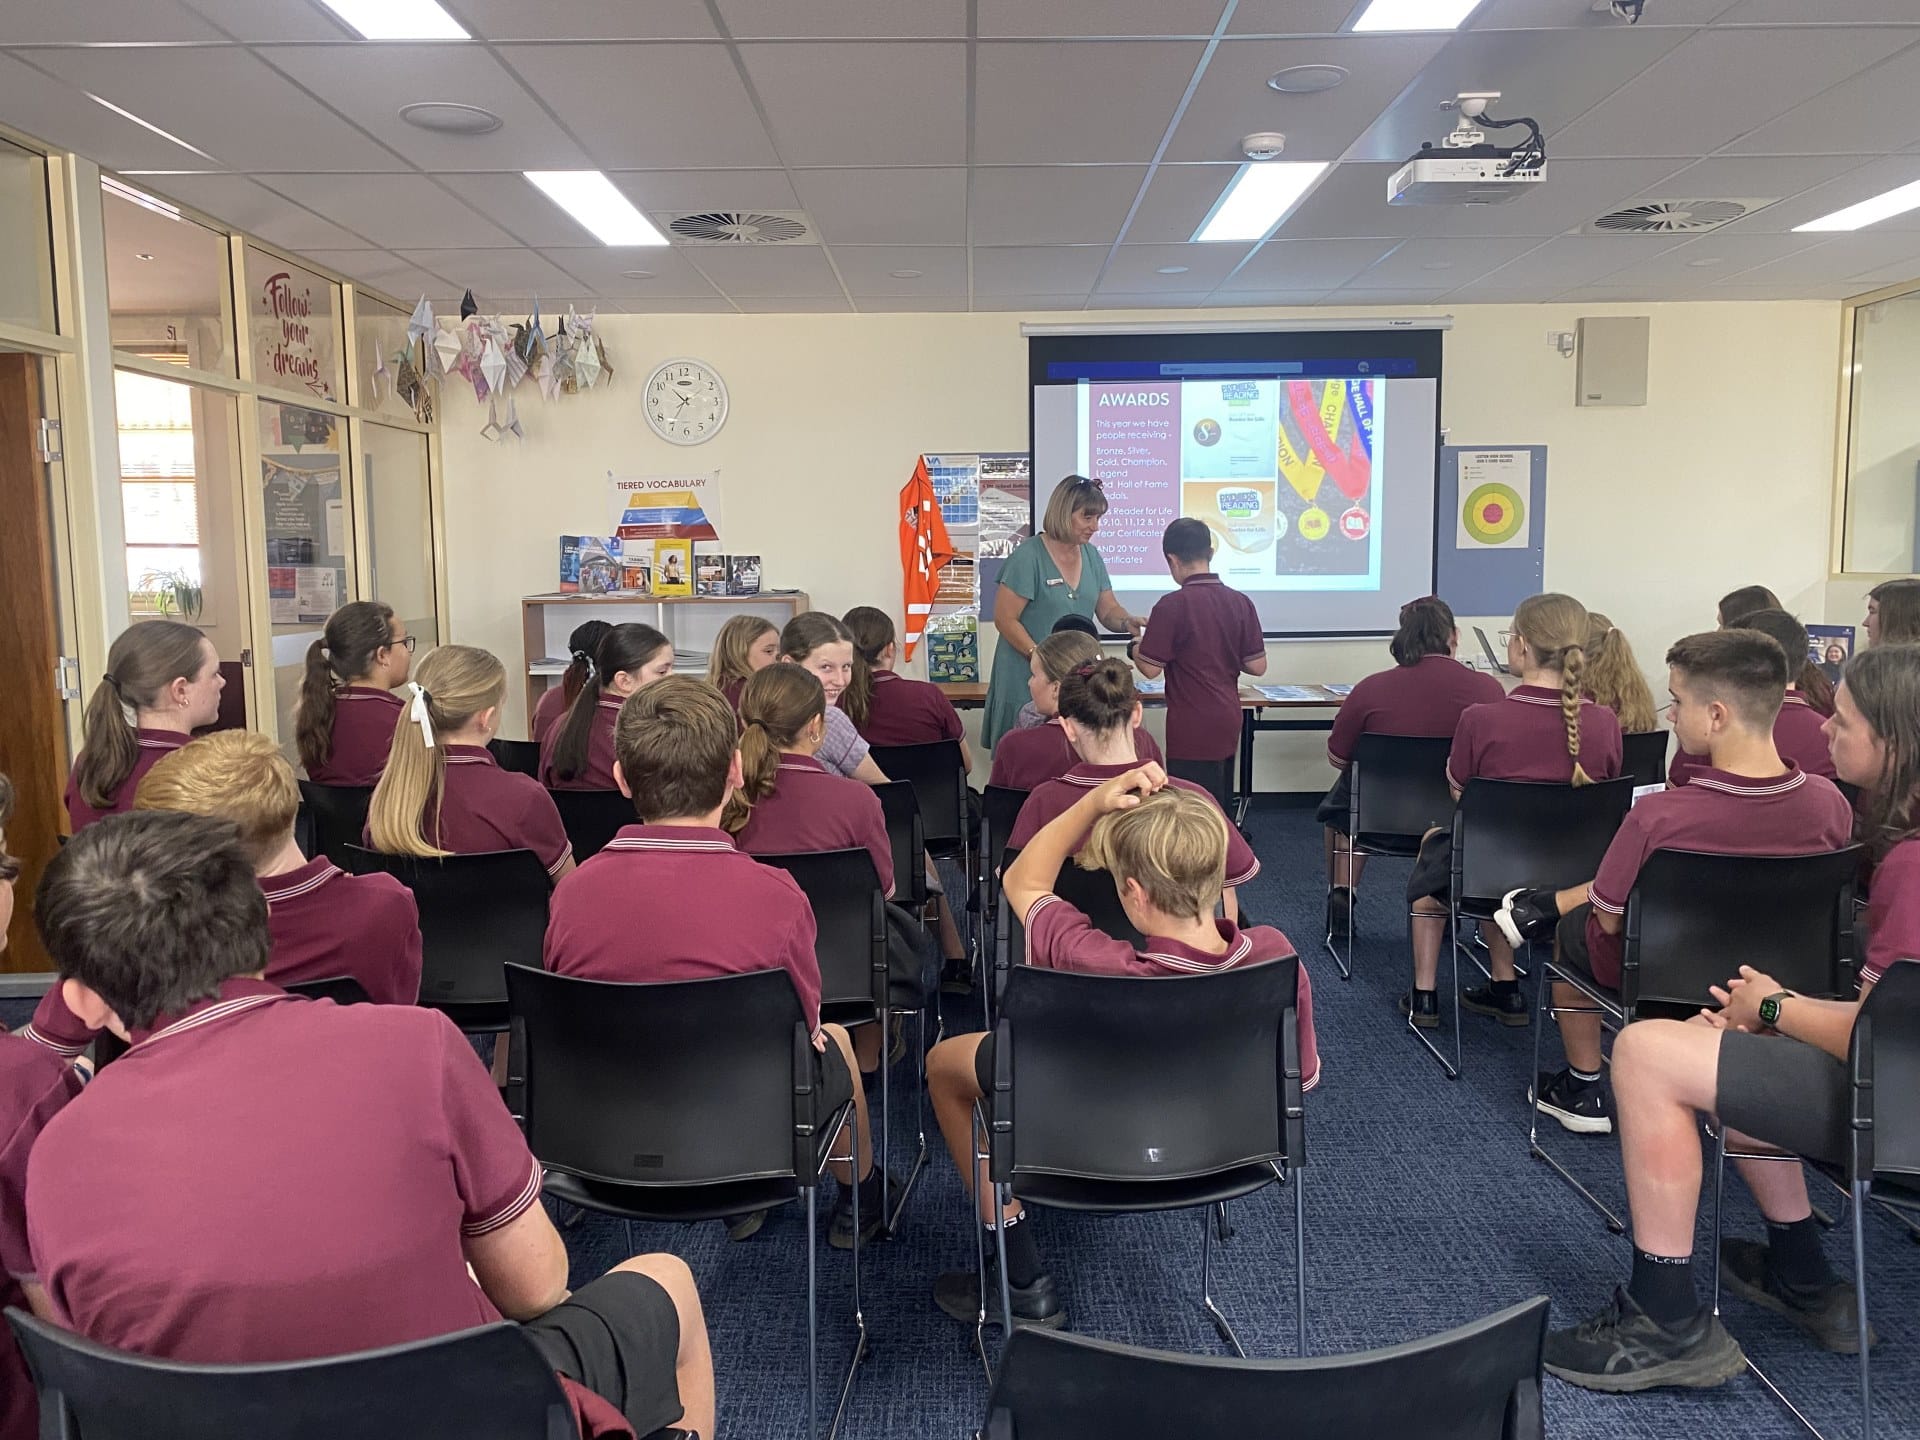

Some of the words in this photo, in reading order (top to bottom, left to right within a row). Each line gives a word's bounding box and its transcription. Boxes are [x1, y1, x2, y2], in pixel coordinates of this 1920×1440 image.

[263, 272, 308, 320] Follow
[282, 318, 309, 348] your
[273, 342, 319, 380] dreams
[665, 372, 674, 380] 11
[679, 368, 689, 376] 12
[656, 382, 666, 391] 10
[1098, 392, 1170, 407] AWARDS
[1096, 420, 1110, 428] This
[1112, 421, 1130, 429] year
[1148, 419, 1169, 428] have
[1096, 430, 1126, 440] people
[1128, 430, 1167, 440] receiving
[1096, 470, 1128, 479] Legend
[616, 481, 644, 490] TIERED
[646, 479, 706, 489] VOCABULARY
[1118, 480, 1132, 488] Hall
[1144, 480, 1168, 488] Fame
[1104, 492, 1128, 500] edals.
[1113, 507, 1144, 516] Reader
[1146, 507, 1156, 516] for
[1158, 506, 1172, 516] Life
[626, 512, 633, 522] 2
[1117, 545, 1126, 553] 20
[1103, 556, 1143, 564] ertificates
